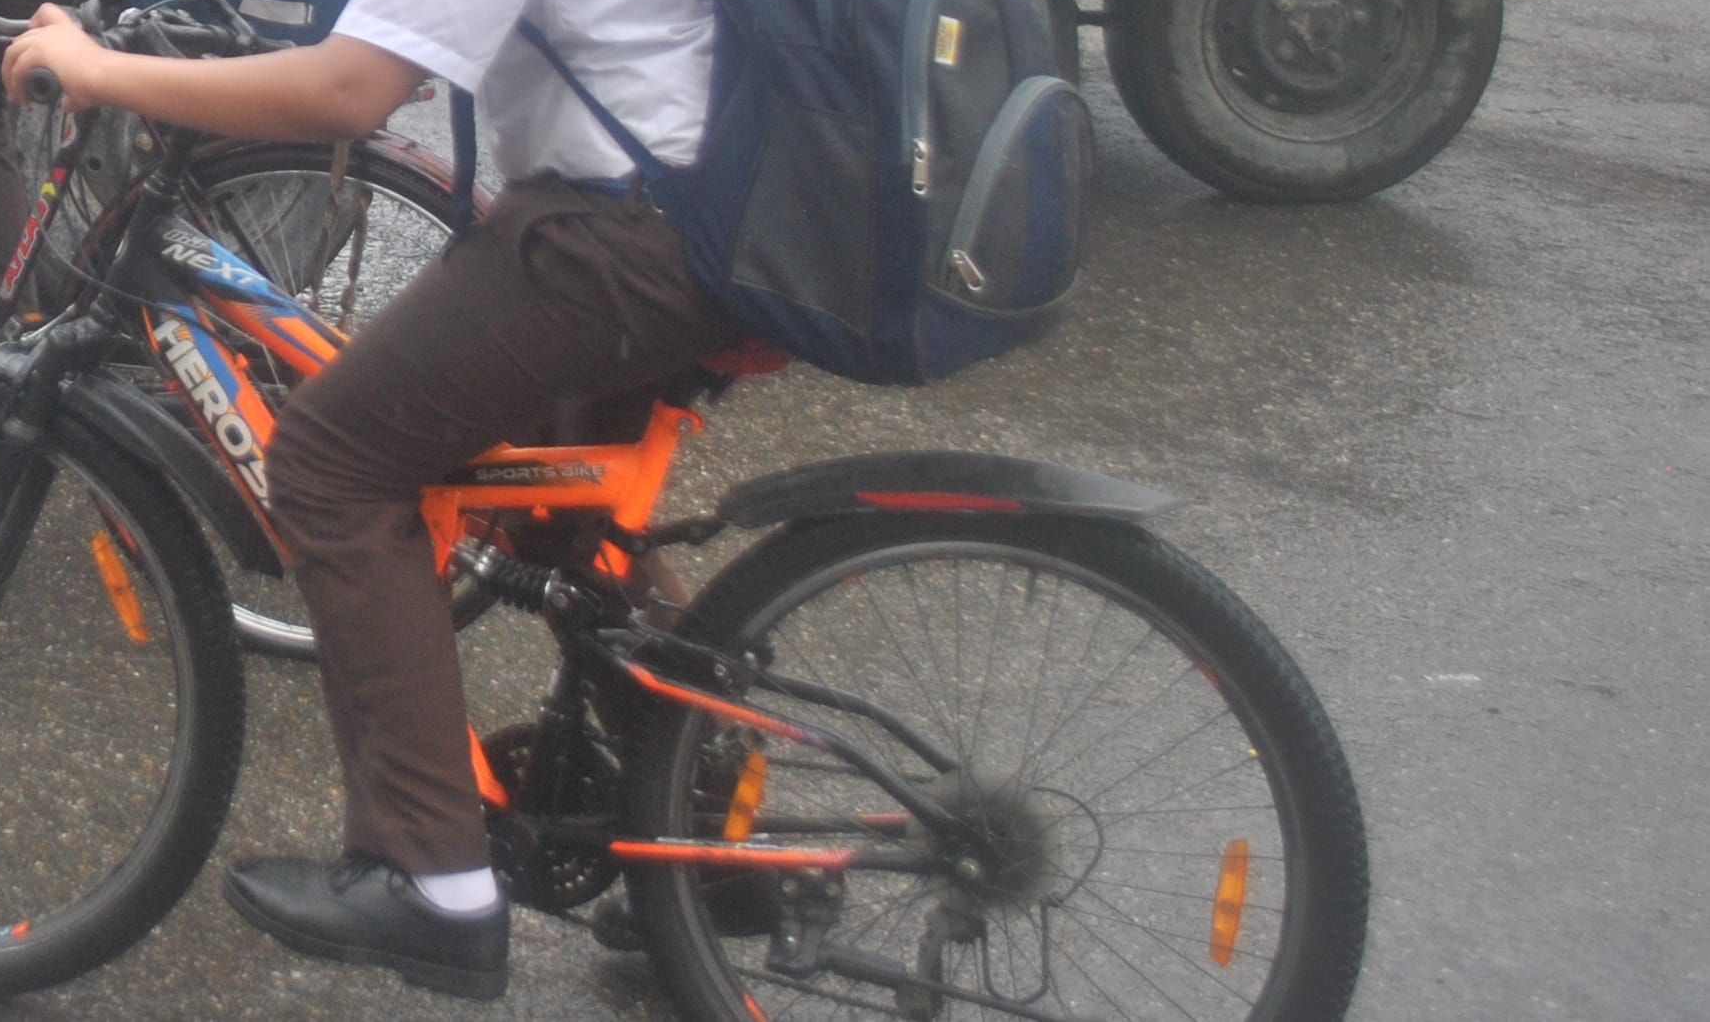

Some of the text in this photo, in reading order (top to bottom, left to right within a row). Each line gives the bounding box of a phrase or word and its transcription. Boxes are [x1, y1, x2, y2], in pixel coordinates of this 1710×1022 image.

[161, 243, 268, 285] NEXT
[475, 464, 606, 482] SPORTS BIKE
